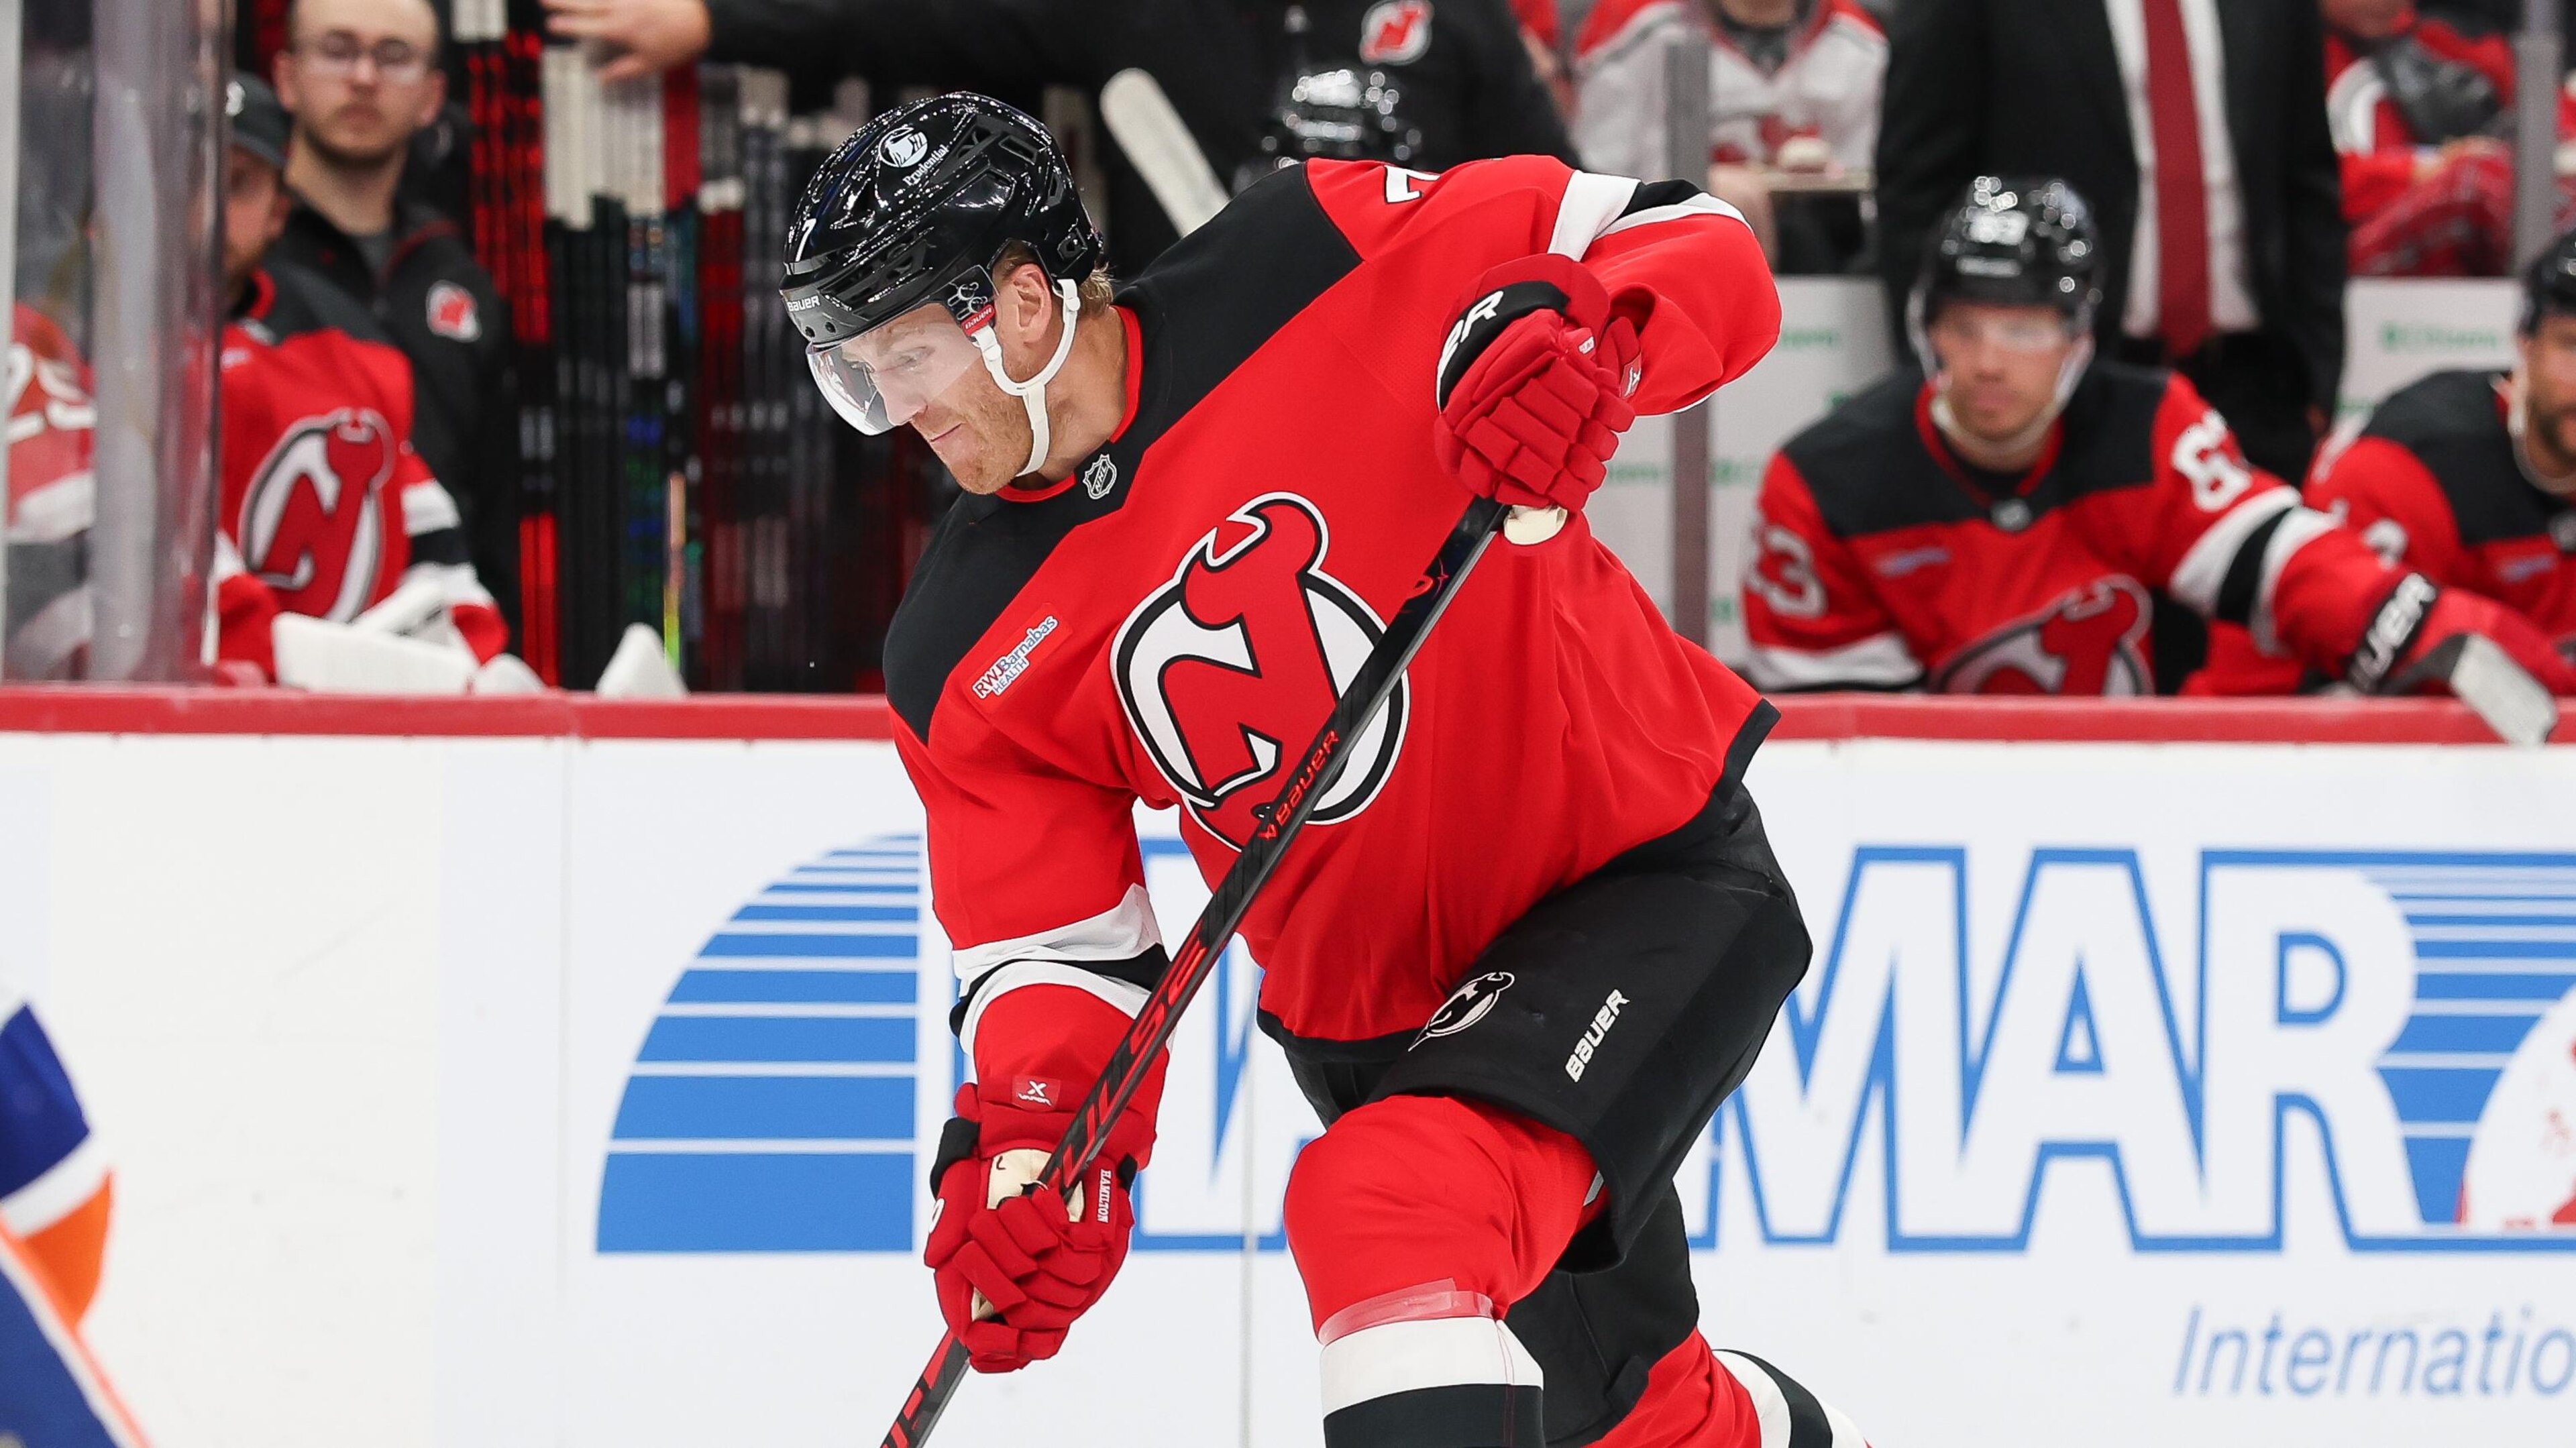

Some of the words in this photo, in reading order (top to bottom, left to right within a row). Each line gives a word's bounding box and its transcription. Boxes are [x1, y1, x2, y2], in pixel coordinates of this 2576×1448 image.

[902, 144, 950, 186] Prudential
[795, 217, 816, 262] 7
[786, 294, 820, 313] BAUER
[974, 617, 1056, 698] RWJBarnabas
[992, 658, 1028, 693] HEALTH
[1275, 730, 1339, 827] BAUER
[1049, 919, 1208, 1188] ULSE
[1564, 988, 1631, 1083] BAUER
[1096, 1168, 1112, 1224] HAMILTON
